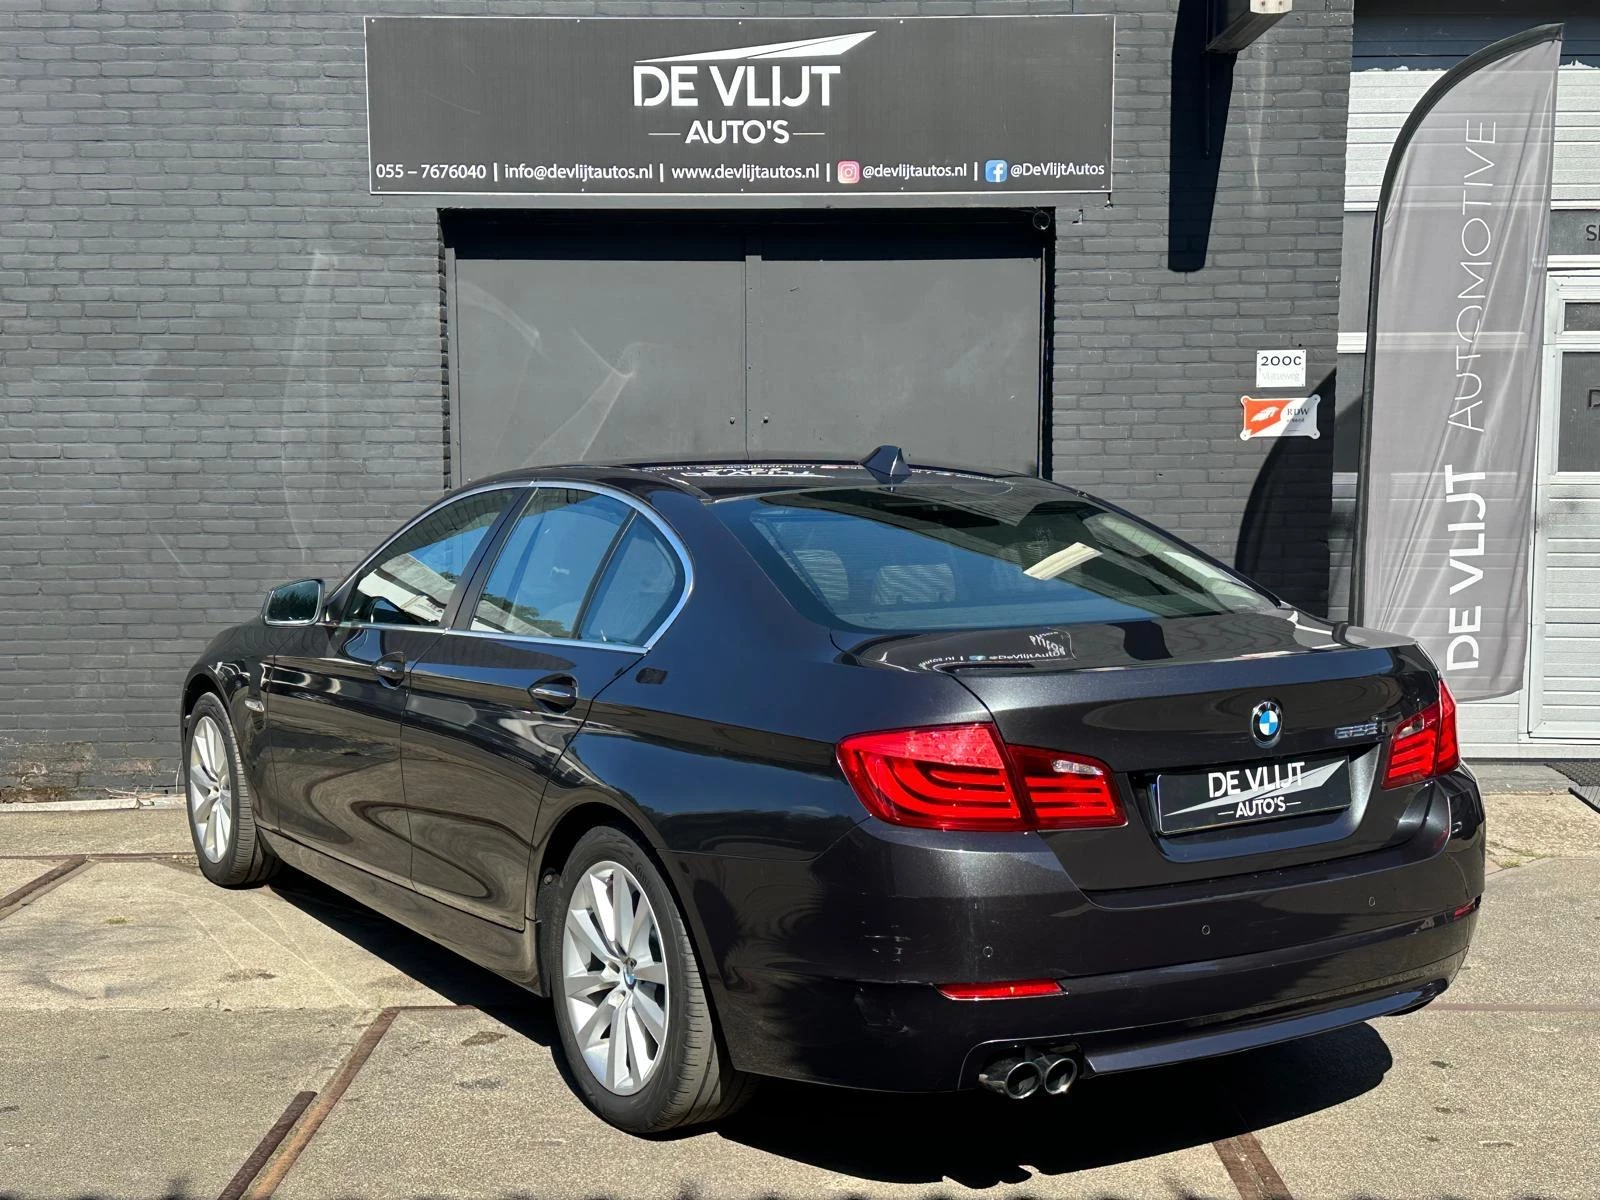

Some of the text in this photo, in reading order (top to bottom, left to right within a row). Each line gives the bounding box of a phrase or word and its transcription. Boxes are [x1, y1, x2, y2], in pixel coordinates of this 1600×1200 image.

[633, 65, 841, 107] DE VLIJT
[685, 119, 790, 145] AUTO'S
[375, 164, 404, 179] 055
[421, 164, 487, 179] 7676040
[504, 163, 653, 182] info@devlijtautos.nl
[671, 163, 820, 182] www.devlijtautos.nl
[862, 163, 967, 181] @devlijtautos.nl
[1010, 162, 1105, 180] @DeVlijtAutos
[1444, 119, 1497, 671] DE VLIJT AUTOMOTIVE
[1287, 407, 1310, 416] RDW
[1207, 761, 1306, 798] DE VLIJT
[1235, 796, 1287, 818] AUTO'S
